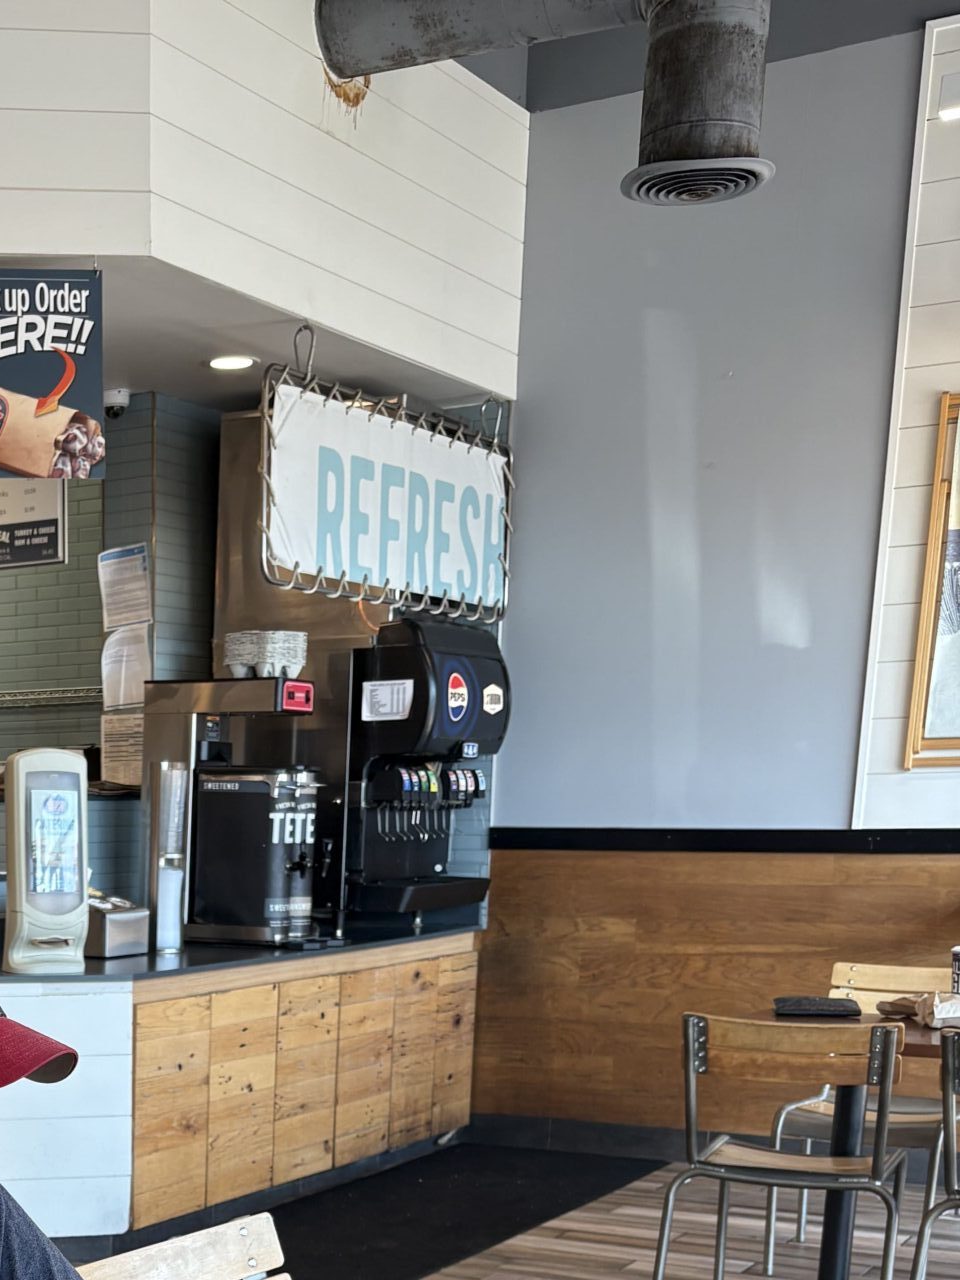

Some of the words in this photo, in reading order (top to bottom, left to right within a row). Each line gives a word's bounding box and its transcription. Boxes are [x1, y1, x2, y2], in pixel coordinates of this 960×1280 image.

[4, 287, 30, 316] up
[35, 282, 90, 313] Order
[316, 445, 504, 608] REFRESH
[269, 812, 294, 844] TE
[293, 812, 316, 844] TE
